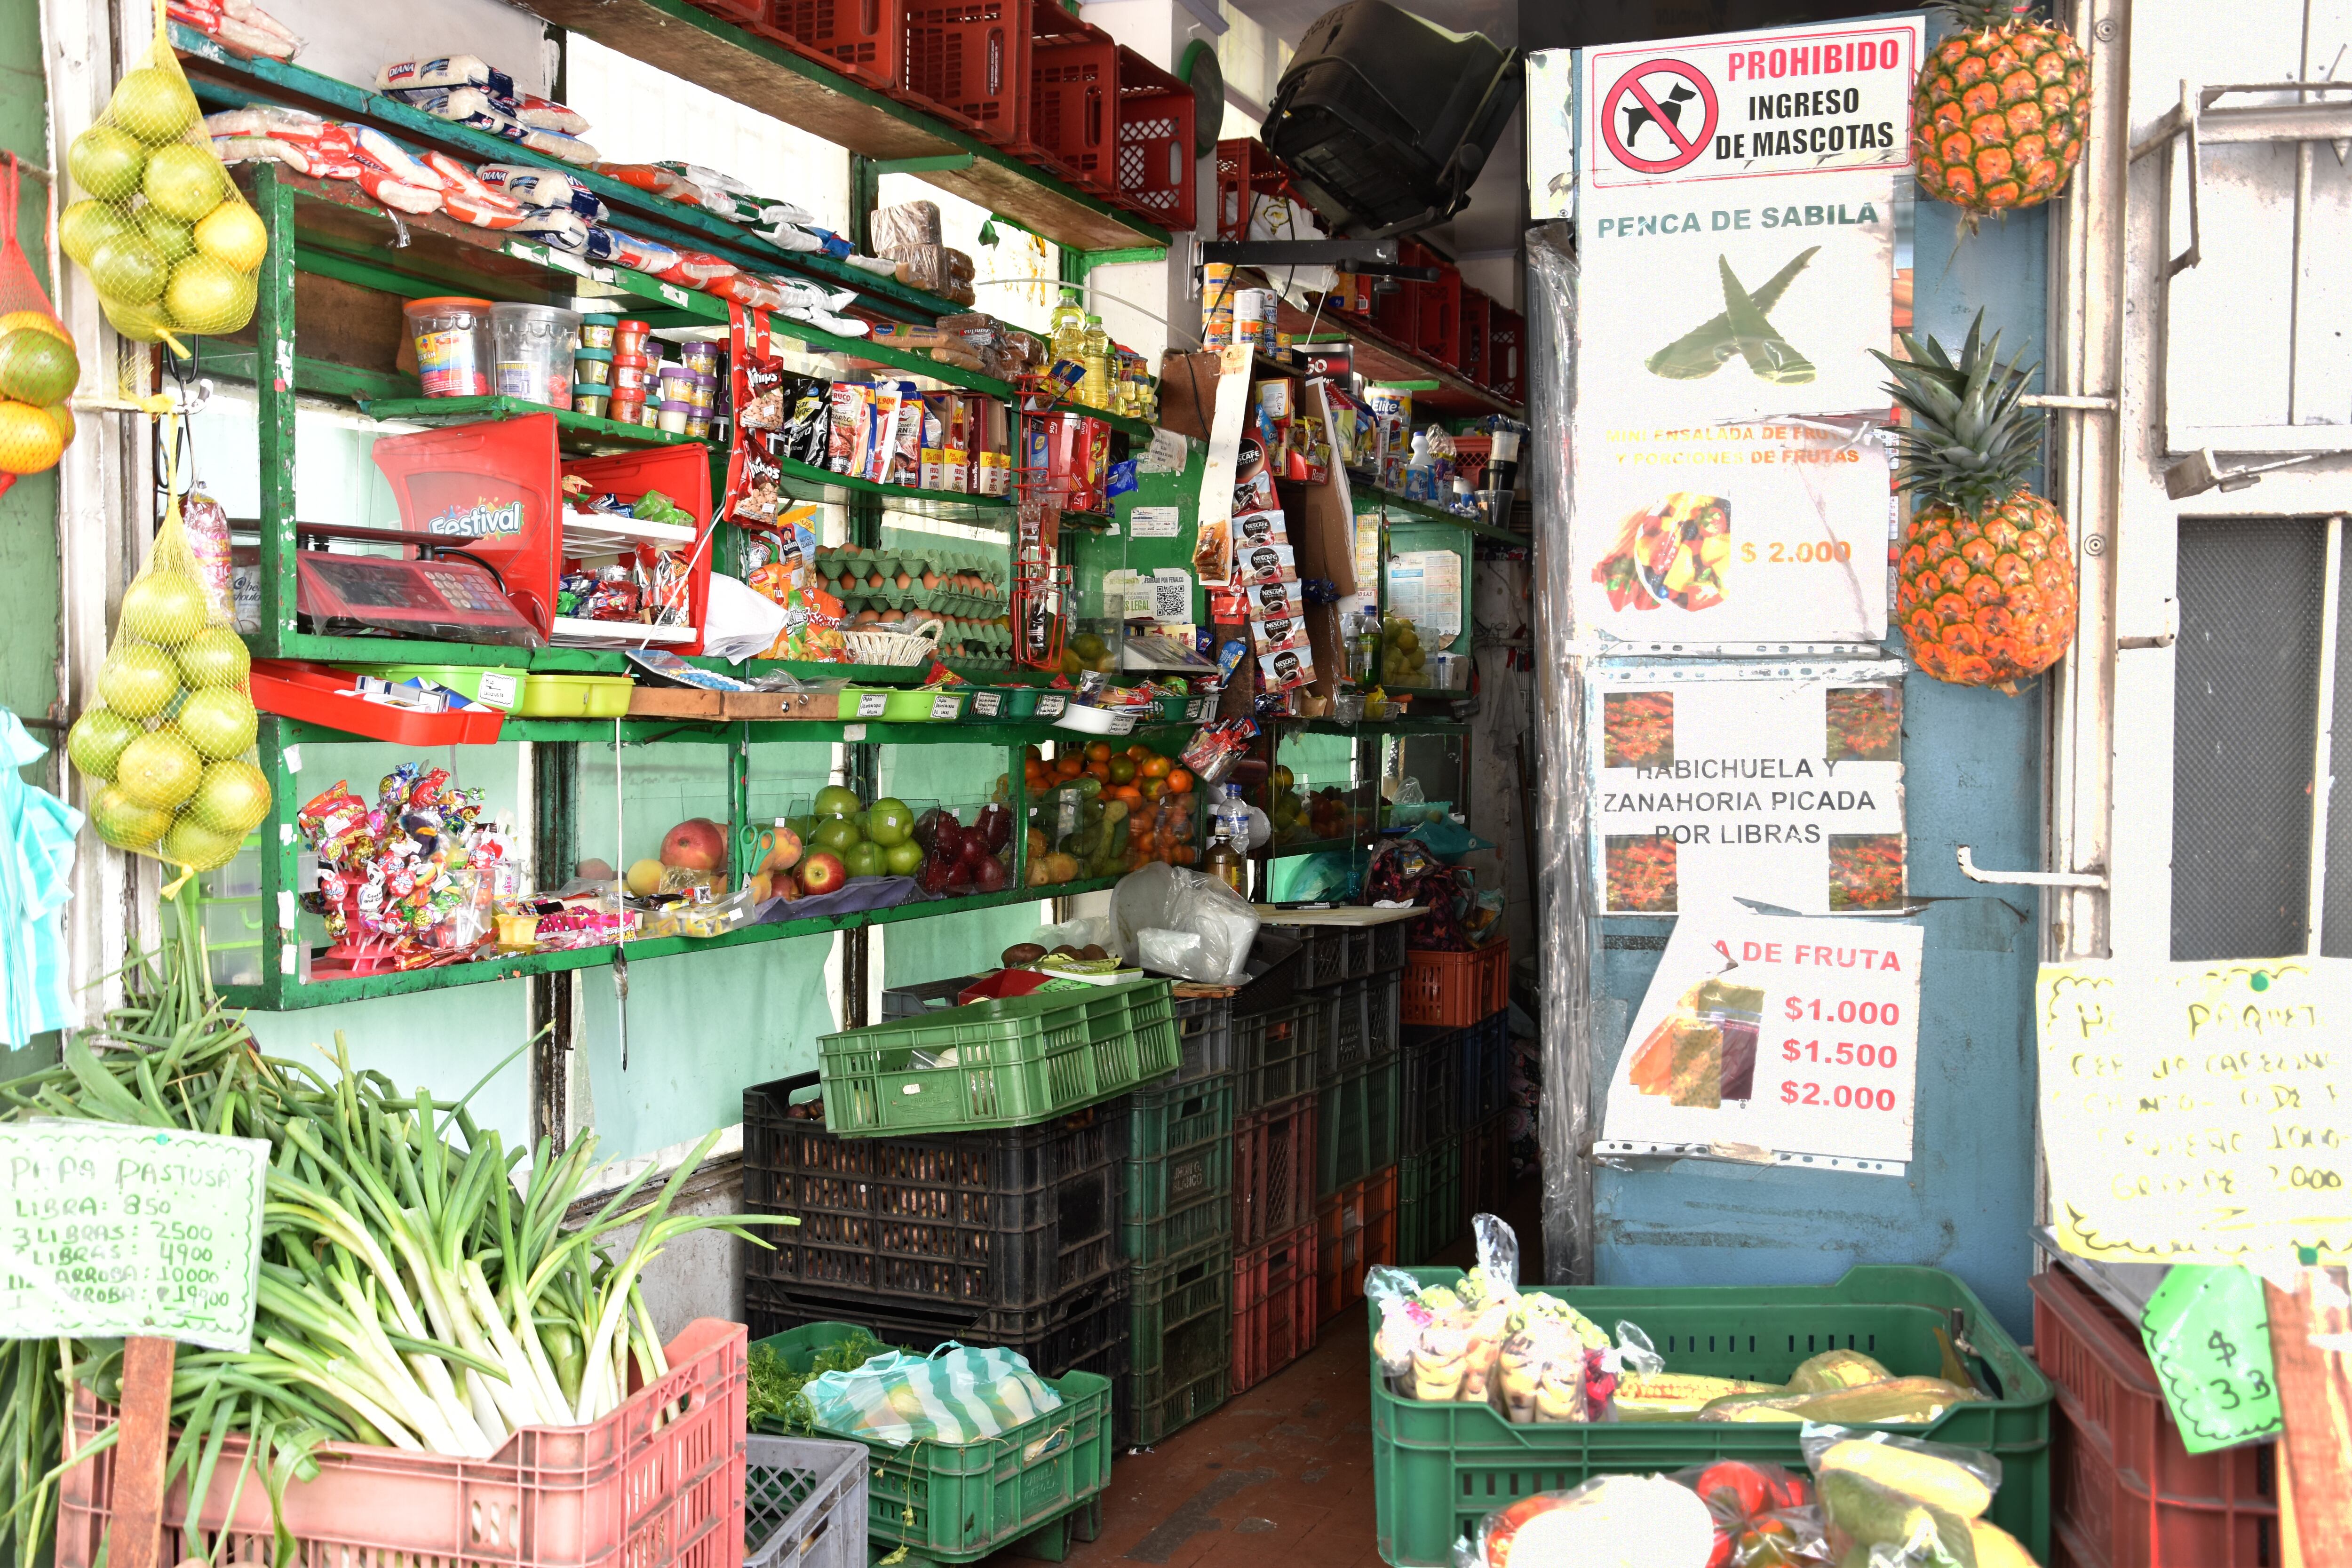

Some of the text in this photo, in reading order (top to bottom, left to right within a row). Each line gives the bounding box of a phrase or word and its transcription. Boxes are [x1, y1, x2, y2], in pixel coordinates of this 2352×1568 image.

[389, 64, 414, 77] DIANA
[1728, 40, 1899, 81] PROHIBIDO
[1749, 88, 1859, 121] INGRESO
[1716, 122, 1893, 159] DE MASCOTAS
[482, 171, 507, 182] DIANA
[1598, 202, 1879, 238] PENCA DE SABILA
[1372, 400, 1397, 412] Elite
[1606, 428, 1647, 443] MINI
[1654, 426, 1756, 441] ENSALADA
[1761, 425, 1786, 440] DE
[1636, 450, 1745, 466] PORCIONES
[1751, 450, 1776, 464] DE
[1781, 449, 1859, 463] FRUTAS
[1311, 469, 1325, 481] Bases
[431, 501, 519, 536] Festival
[1740, 541, 1851, 564] $ 2.000
[1131, 600, 1150, 611] LEGAL
[1637, 757, 1839, 779] HABICHUELA Y
[1604, 790, 1875, 812] ZANAHORIA PICADA
[1655, 823, 1821, 844] POR LIBRAS
[1743, 940, 1782, 963] DE
[1795, 945, 1901, 972] FRUTA
[1784, 996, 1899, 1026] $1.000
[1782, 1038, 1898, 1069] $1.500
[1780, 1080, 1896, 1112] $2.000
[115, 1158, 230, 1189] PASTUSA
[16, 1194, 171, 1221] LIBRA: 850
[150, 1220, 213, 1241] 2500
[160, 1242, 213, 1266] 4900
[157, 1266, 219, 1283] 10000
